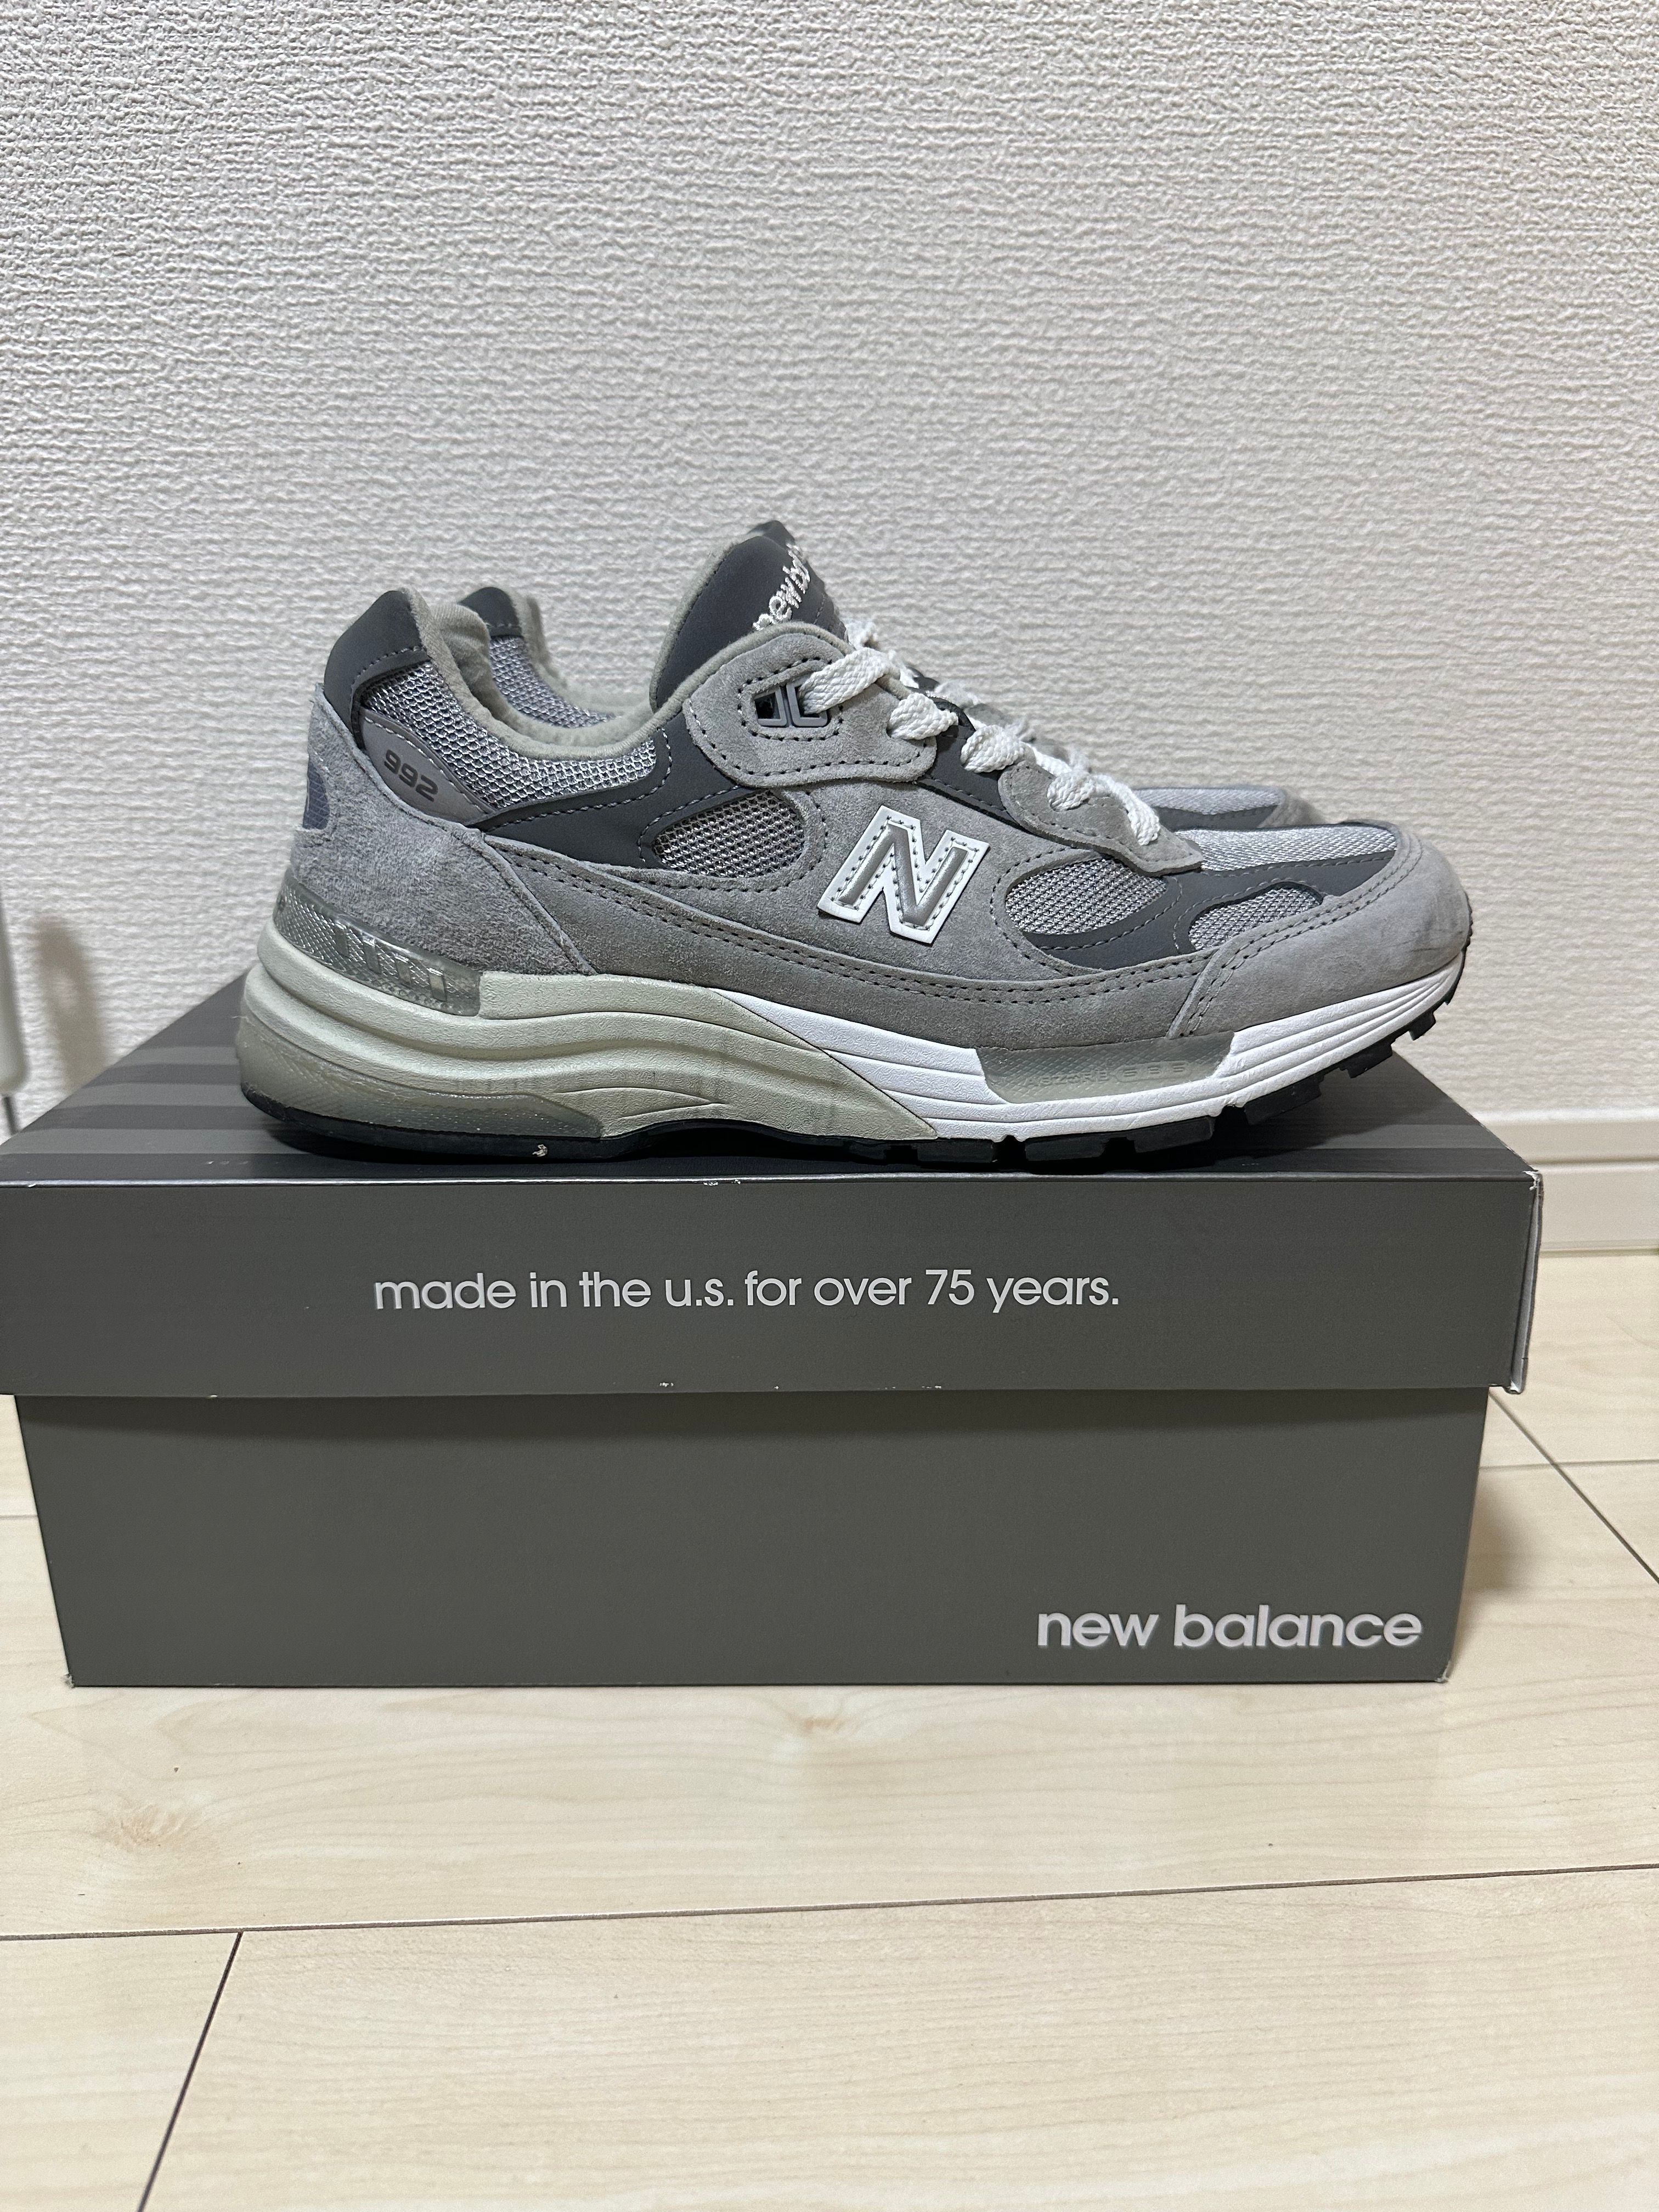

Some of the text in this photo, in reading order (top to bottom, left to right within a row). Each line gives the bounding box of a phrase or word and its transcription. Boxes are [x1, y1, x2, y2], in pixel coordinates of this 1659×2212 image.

[383, 749, 439, 802] 992
[817, 805, 990, 944] N
[375, 1268, 1119, 1313] made in the u.s. for over 75 years.
[1037, 1604, 1423, 1647] new balance
